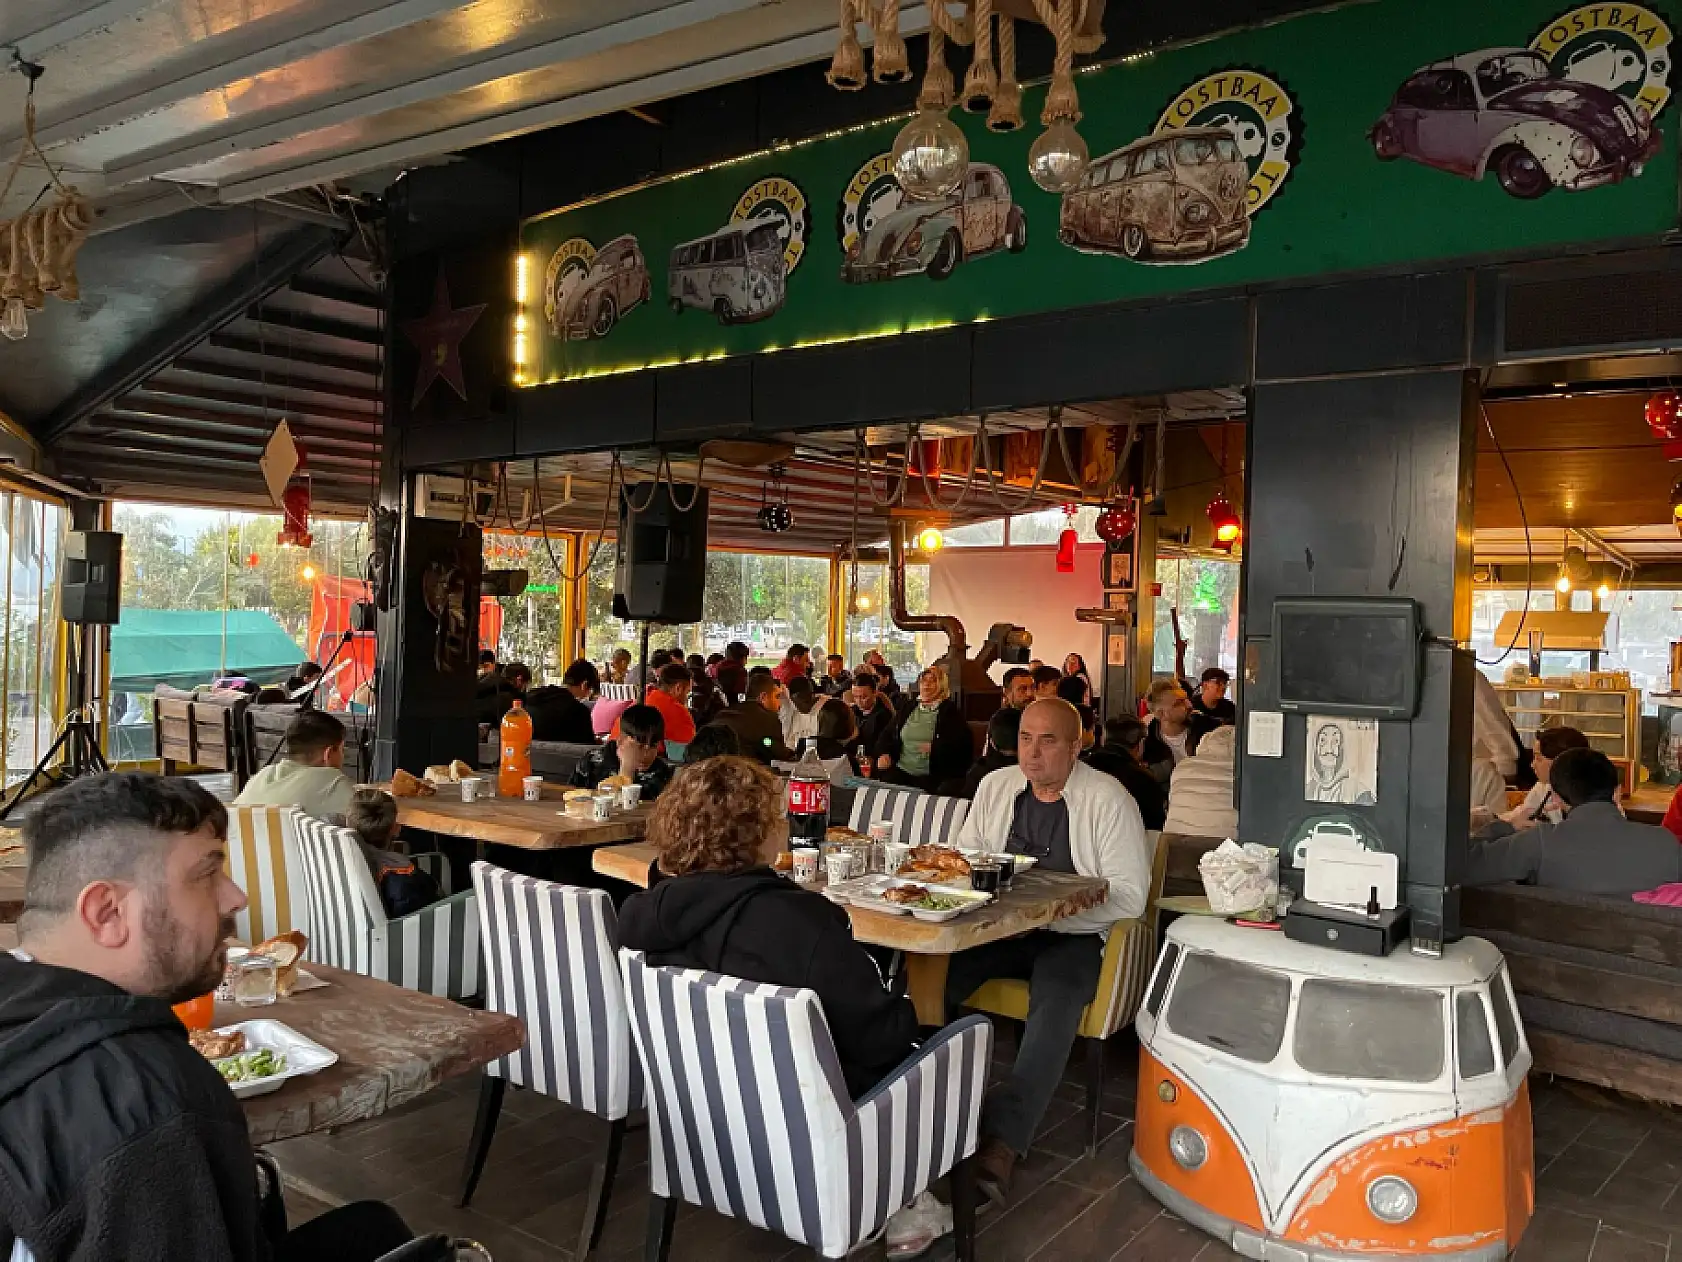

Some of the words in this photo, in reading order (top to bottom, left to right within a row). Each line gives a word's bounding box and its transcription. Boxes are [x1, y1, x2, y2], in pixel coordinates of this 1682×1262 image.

[1535, 8, 1659, 56] TOSTBAA
[1161, 77, 1279, 130] TOSTBAA
[734, 182, 798, 219] TOSTBAA
